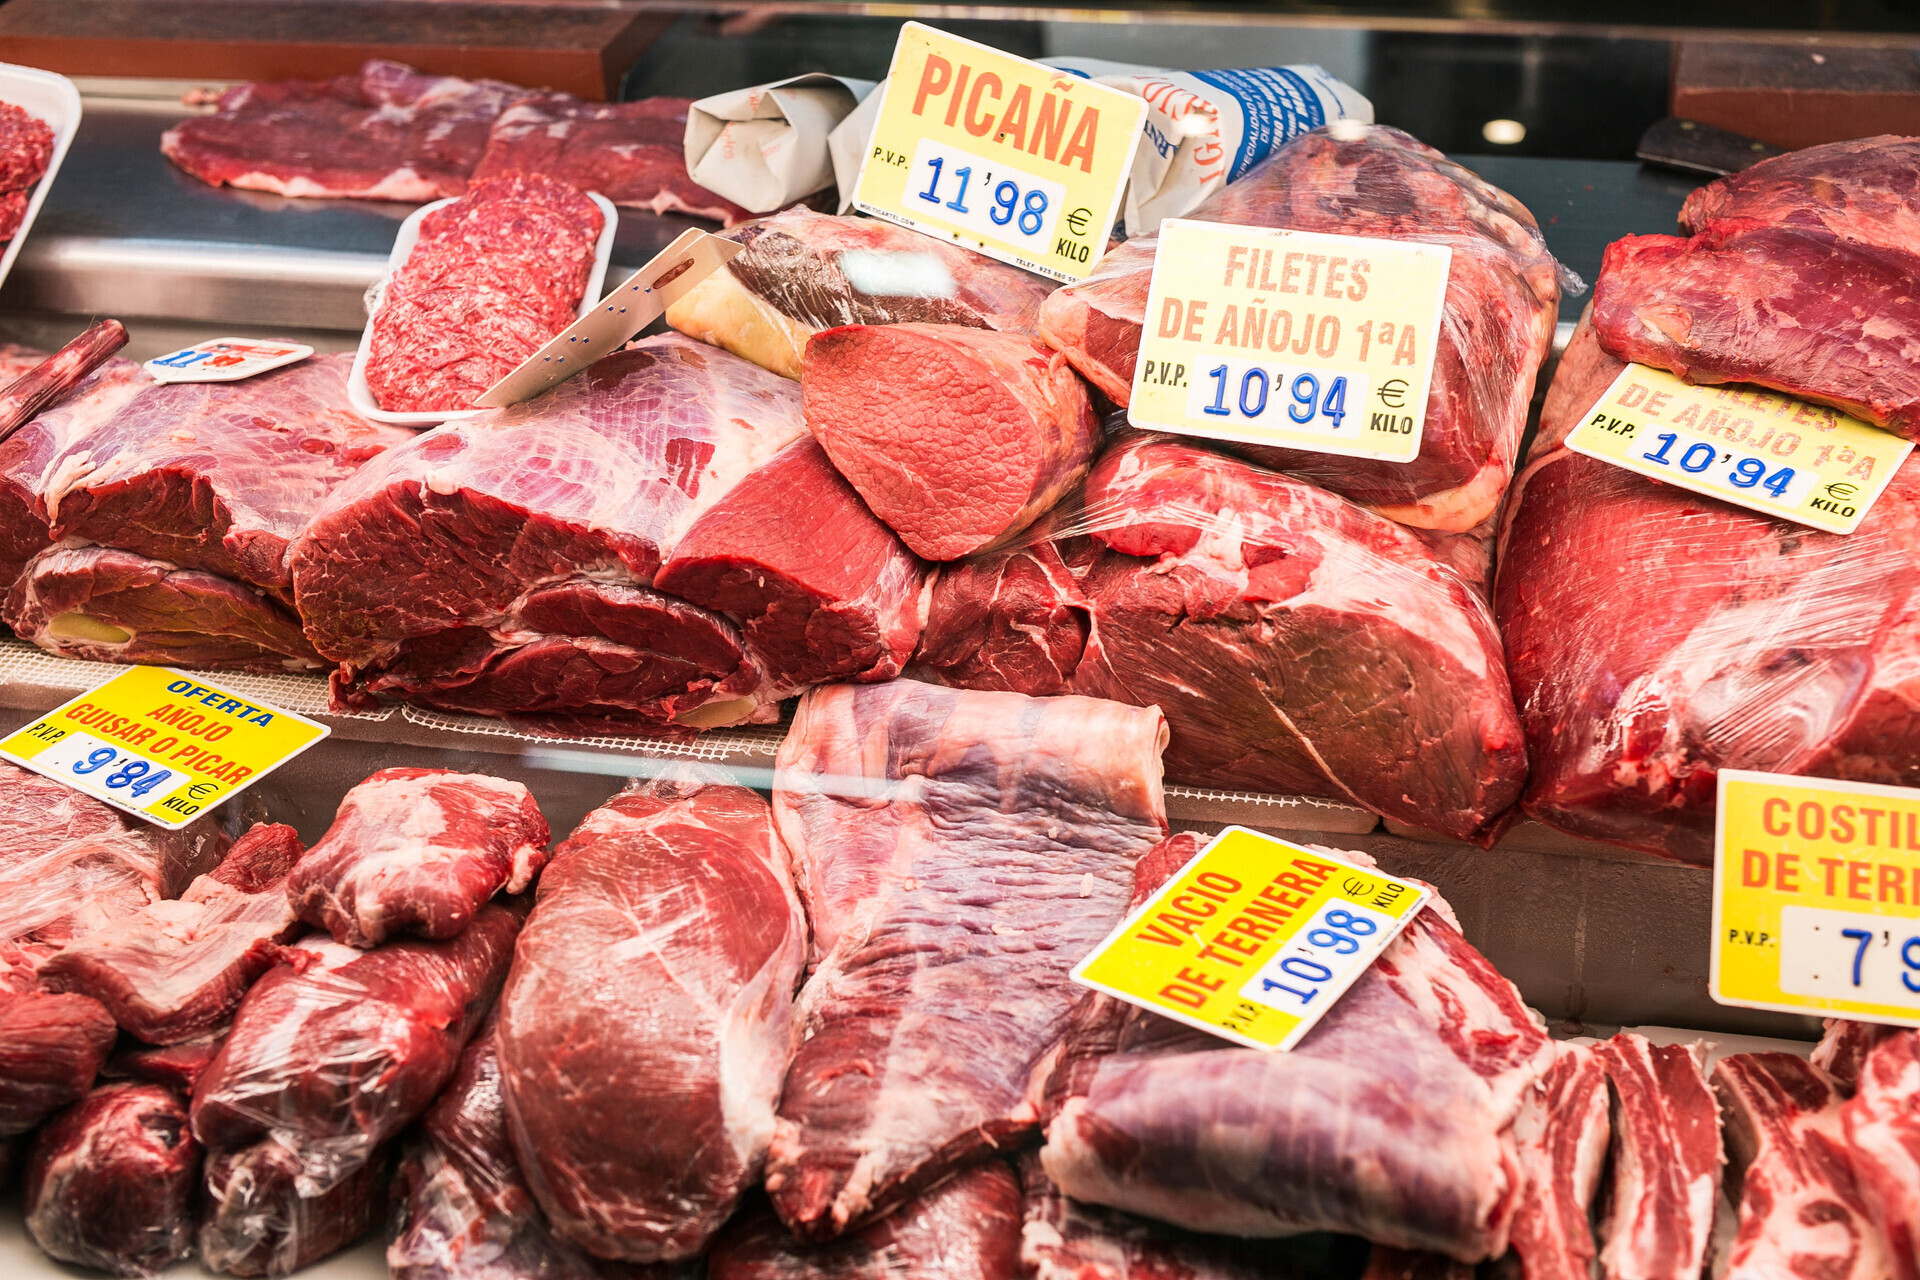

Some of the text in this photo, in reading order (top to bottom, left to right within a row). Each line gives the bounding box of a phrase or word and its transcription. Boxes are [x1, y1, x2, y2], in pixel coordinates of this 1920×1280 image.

[912, 53, 1100, 174] PICAÑA
[873, 147, 908, 169] P.V.P.
[919, 157, 1048, 236] 11'98
[1066, 208, 1093, 236] €
[1056, 238, 1090, 263] KILO
[1224, 246, 1371, 301] FILETES
[1158, 297, 1208, 341] DE
[1215, 298, 1341, 358] AÑOJO
[1143, 361, 1187, 387] P.V.P.
[1204, 364, 1348, 429] 10'94
[1377, 379, 1409, 408] €
[1696, 386, 1844, 432] ILETES
[1370, 413, 1413, 434] KILO
[1590, 413, 1635, 439] P.V.P.
[1616, 383, 1673, 416] DE
[1672, 403, 1802, 457] AÑOJO
[1643, 433, 1796, 498] 10'94
[1809, 498, 1856, 518] KILO
[1824, 483, 1859, 500] €
[167, 680, 274, 727] OFERTA
[26, 723, 66, 744] P.V.P.
[146, 705, 233, 742] AÑOJO
[66, 703, 252, 786] GUISAR O PICAR
[72, 747, 172, 798] 9'84
[162, 796, 200, 816] KILO
[188, 783, 219, 800] €
[1343, 877, 1374, 898] €
[1742, 849, 1800, 893] DE
[1136, 872, 1242, 949] VACIO
[1371, 883, 1405, 909] KILO
[1158, 967, 1225, 1009] DE
[1196, 858, 1338, 968] TERNERA
[1729, 929, 1775, 948] P.V.P.
[1263, 910, 1377, 1004] 10'98
